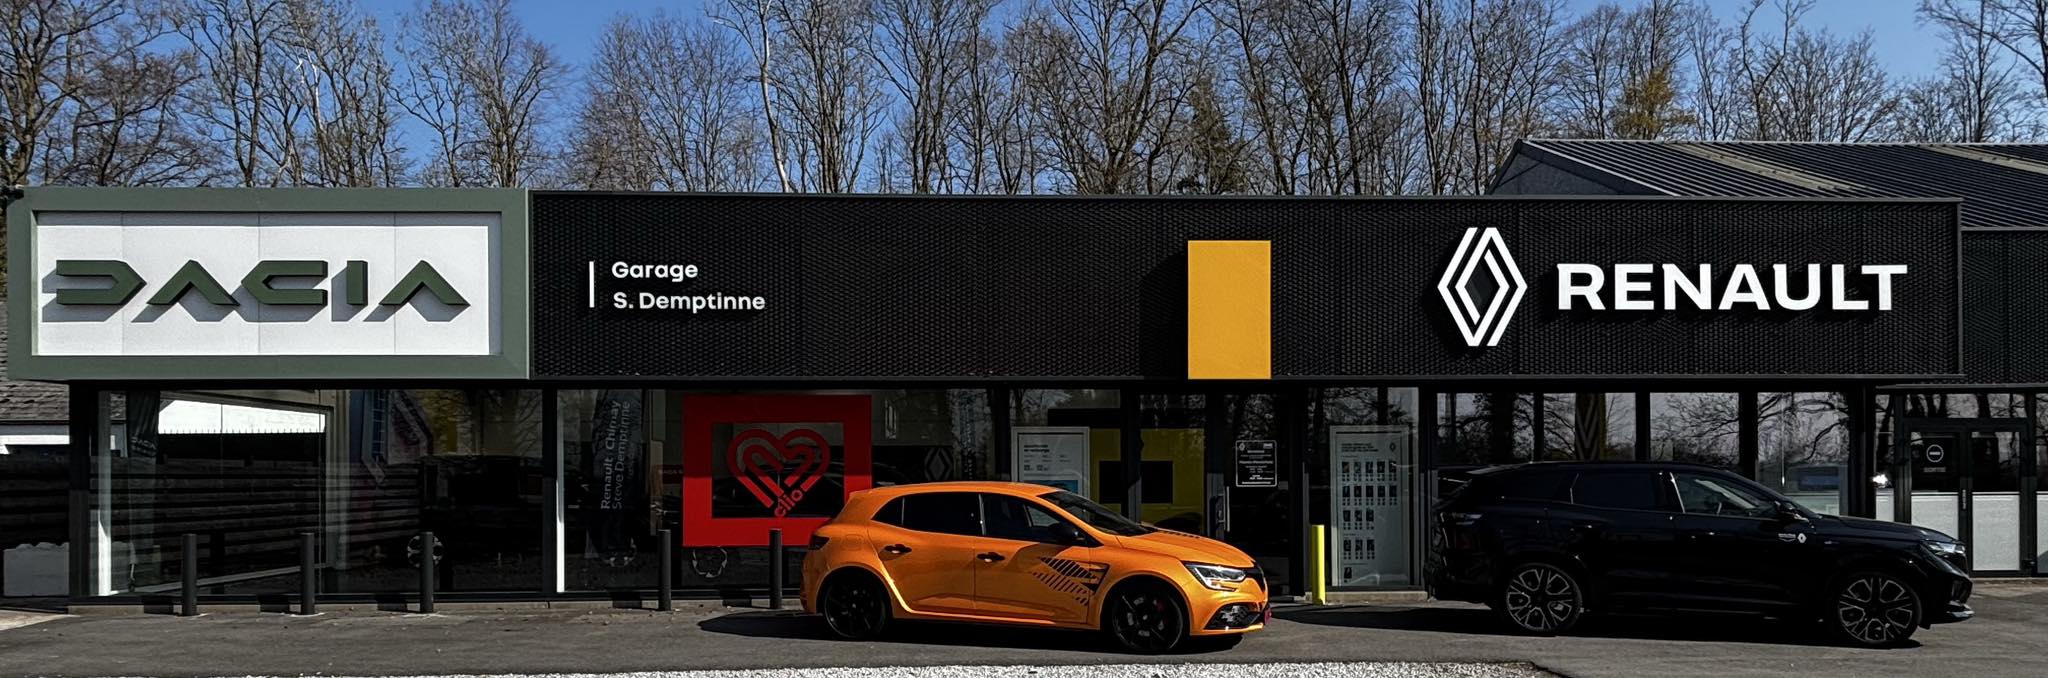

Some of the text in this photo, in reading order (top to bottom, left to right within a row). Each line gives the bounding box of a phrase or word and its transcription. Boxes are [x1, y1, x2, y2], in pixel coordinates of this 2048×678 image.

[56, 260, 470, 306] DACIA
[612, 261, 698, 282] Garage
[1557, 263, 1908, 311] RENAULT
[613, 291, 766, 314] S. Demptinne
[600, 400, 621, 510] Renault Chimay
[614, 401, 631, 472] Demptinne
[611, 473, 624, 510] Steve
[774, 489, 804, 517] clio
